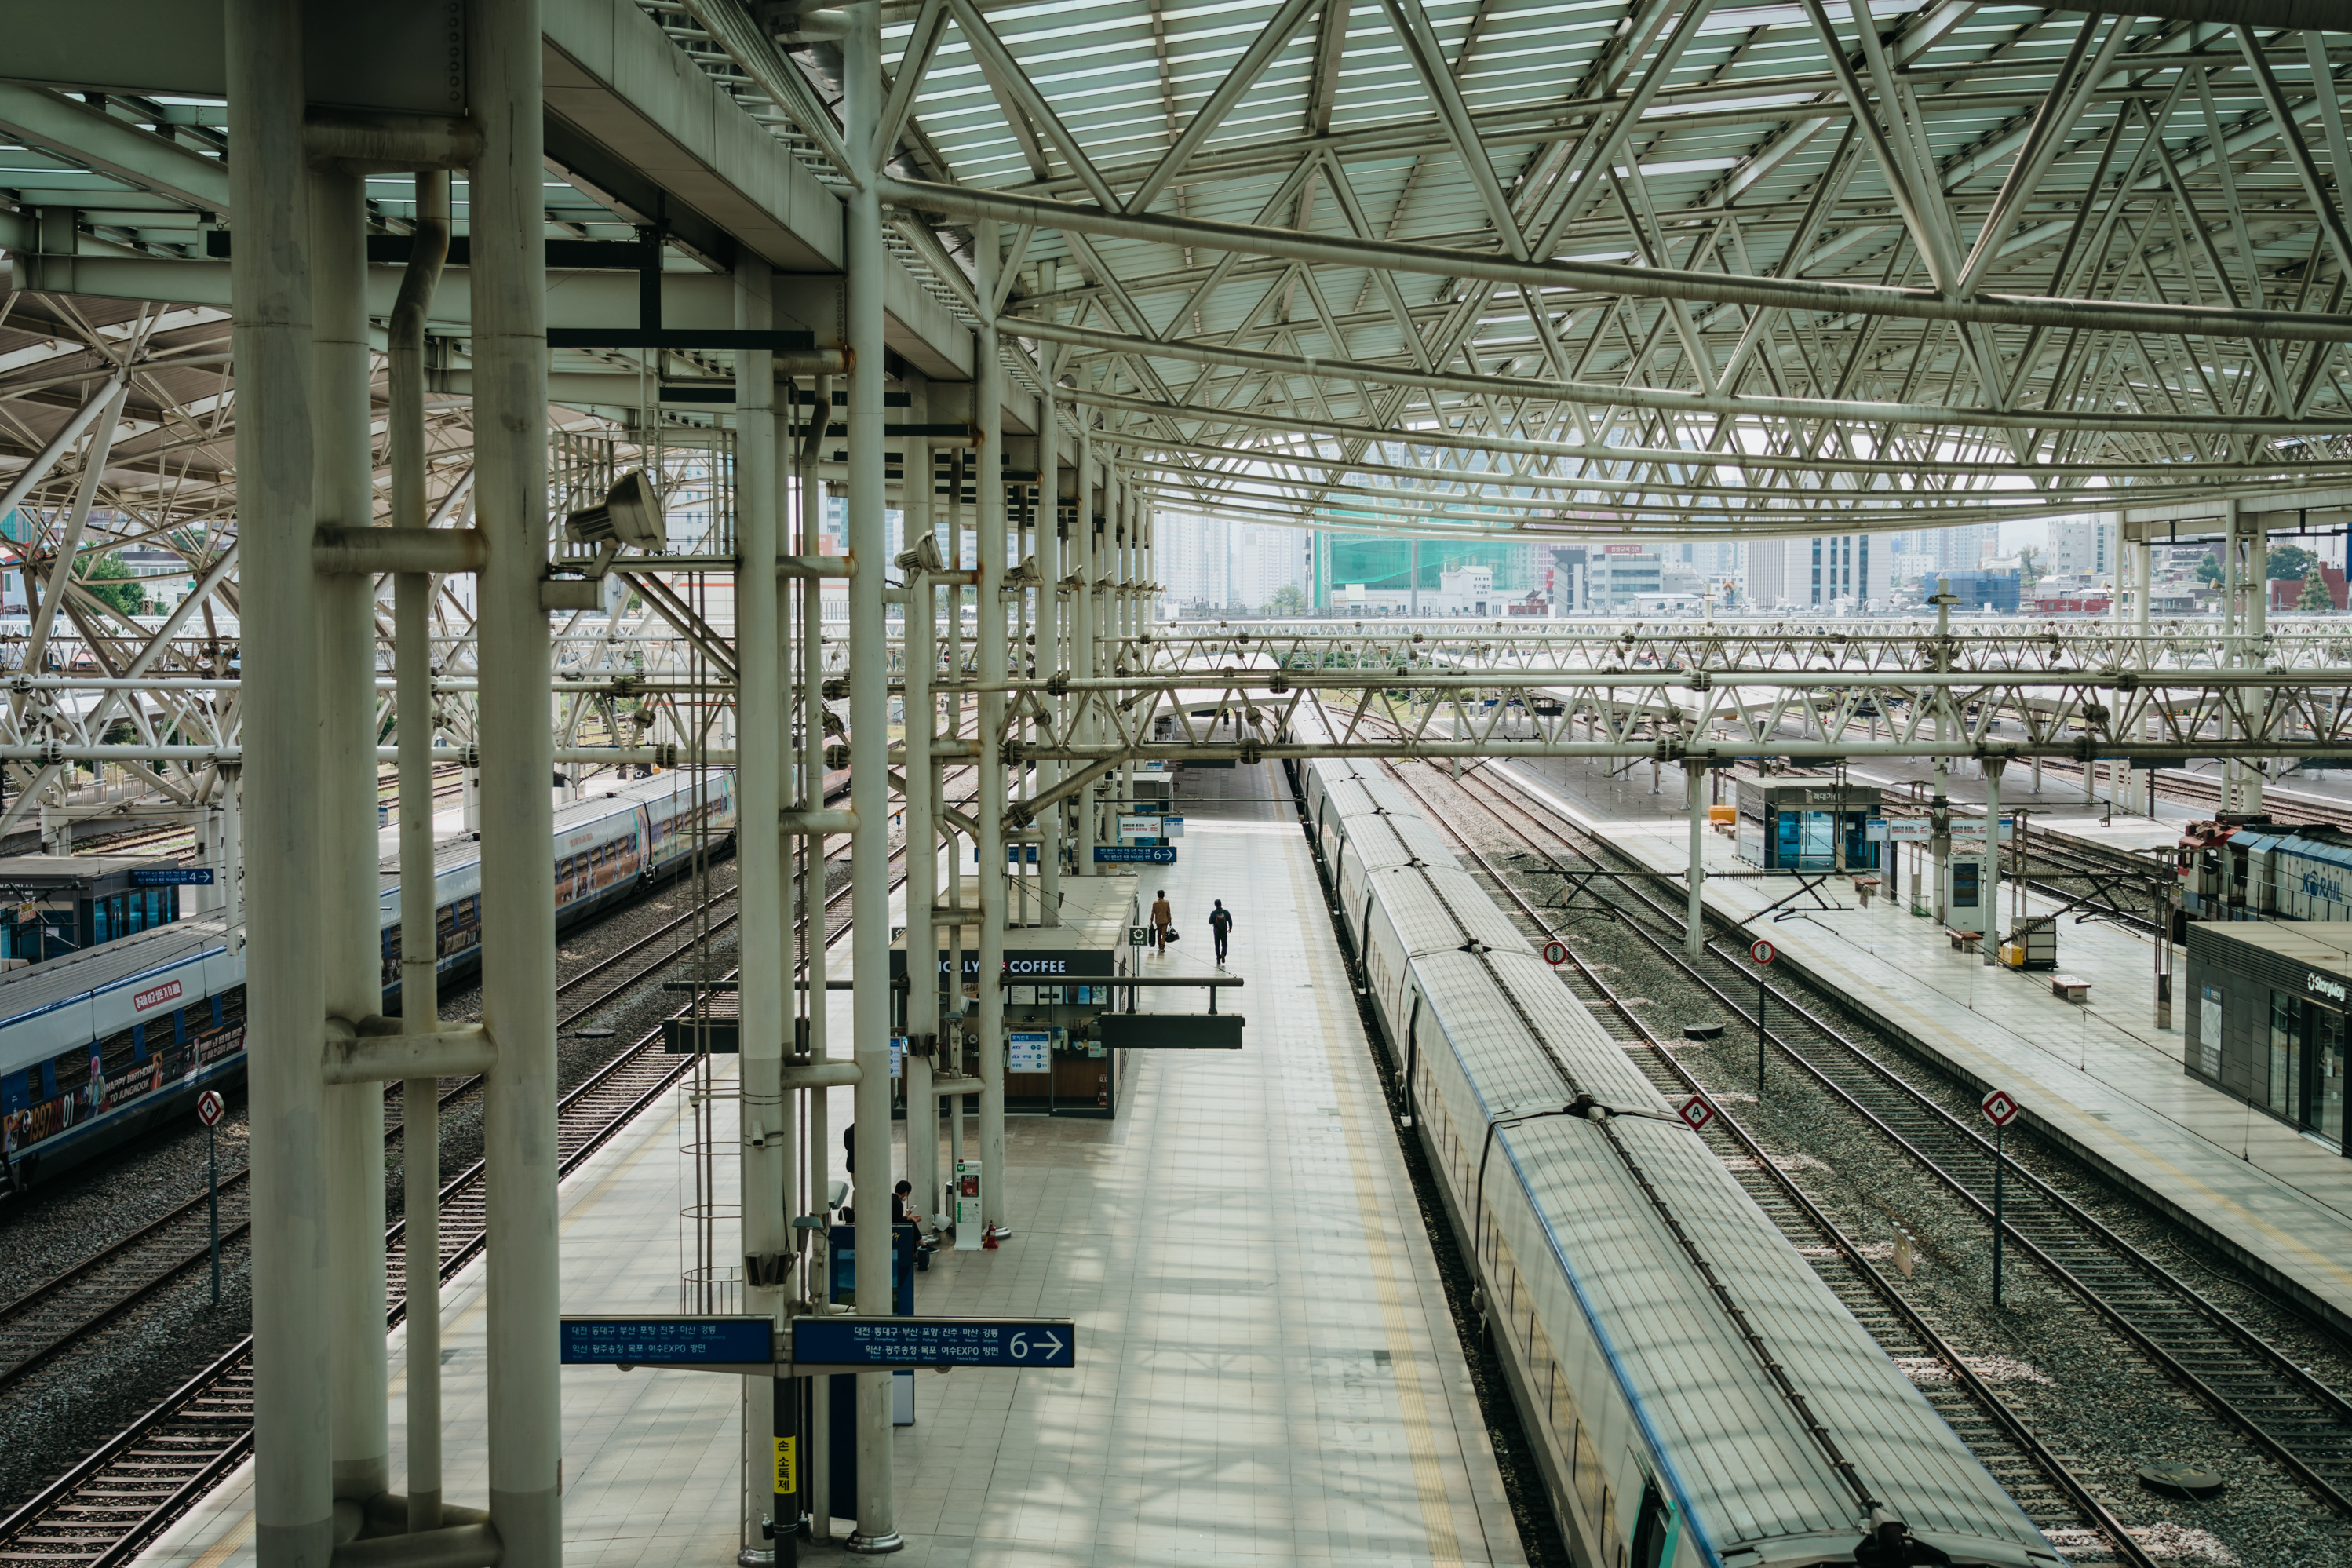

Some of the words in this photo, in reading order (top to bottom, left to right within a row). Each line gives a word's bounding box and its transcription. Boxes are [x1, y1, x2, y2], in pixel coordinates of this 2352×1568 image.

[1154, 850, 1161, 860] 6
[189, 872, 196, 881] 4
[2301, 870, 2343, 902] KORAIL
[1009, 961, 1066, 973] COFFEE
[106, 1076, 126, 1092] HAPPY
[126, 1063, 155, 1082] BIRTHDAY
[110, 1093, 118, 1103] TO
[119, 1078, 150, 1100] JUNGKOOK
[206, 1101, 213, 1113] A
[1691, 1106, 1701, 1118] A
[1995, 1101, 2005, 1112] A
[571, 1326, 587, 1335] 대전
[592, 1326, 615, 1335] 동대구
[620, 1326, 636, 1335] 부산
[640, 1326, 656, 1335] 포항
[660, 1326, 675, 1335] 진주
[680, 1326, 696, 1335] 마산
[701, 1326, 716, 1335] 강릉
[854, 1327, 870, 1336] 대전
[874, 1327, 898, 1336] 동대구
[902, 1328, 918, 1336] 부산
[922, 1328, 938, 1336] 포항
[943, 1328, 957, 1336] 진주
[962, 1328, 979, 1337] 마산
[983, 1328, 998, 1337] 강릉
[572, 1344, 588, 1353] 익산
[593, 1344, 624, 1353] 광주송정
[628, 1344, 644, 1353] 목포
[648, 1344, 686, 1353] 여수EXPO
[691, 1344, 706, 1353] 방면
[866, 1345, 881, 1354] 익산
[885, 1345, 917, 1355] 광주송정
[921, 1346, 936, 1355] 목포
[942, 1347, 979, 1355] 여수EXPO
[983, 1347, 998, 1356] 방면
[1010, 1332, 1028, 1358] 6
[778, 1441, 789, 1451] 손
[778, 1457, 789, 1491] 소독제
